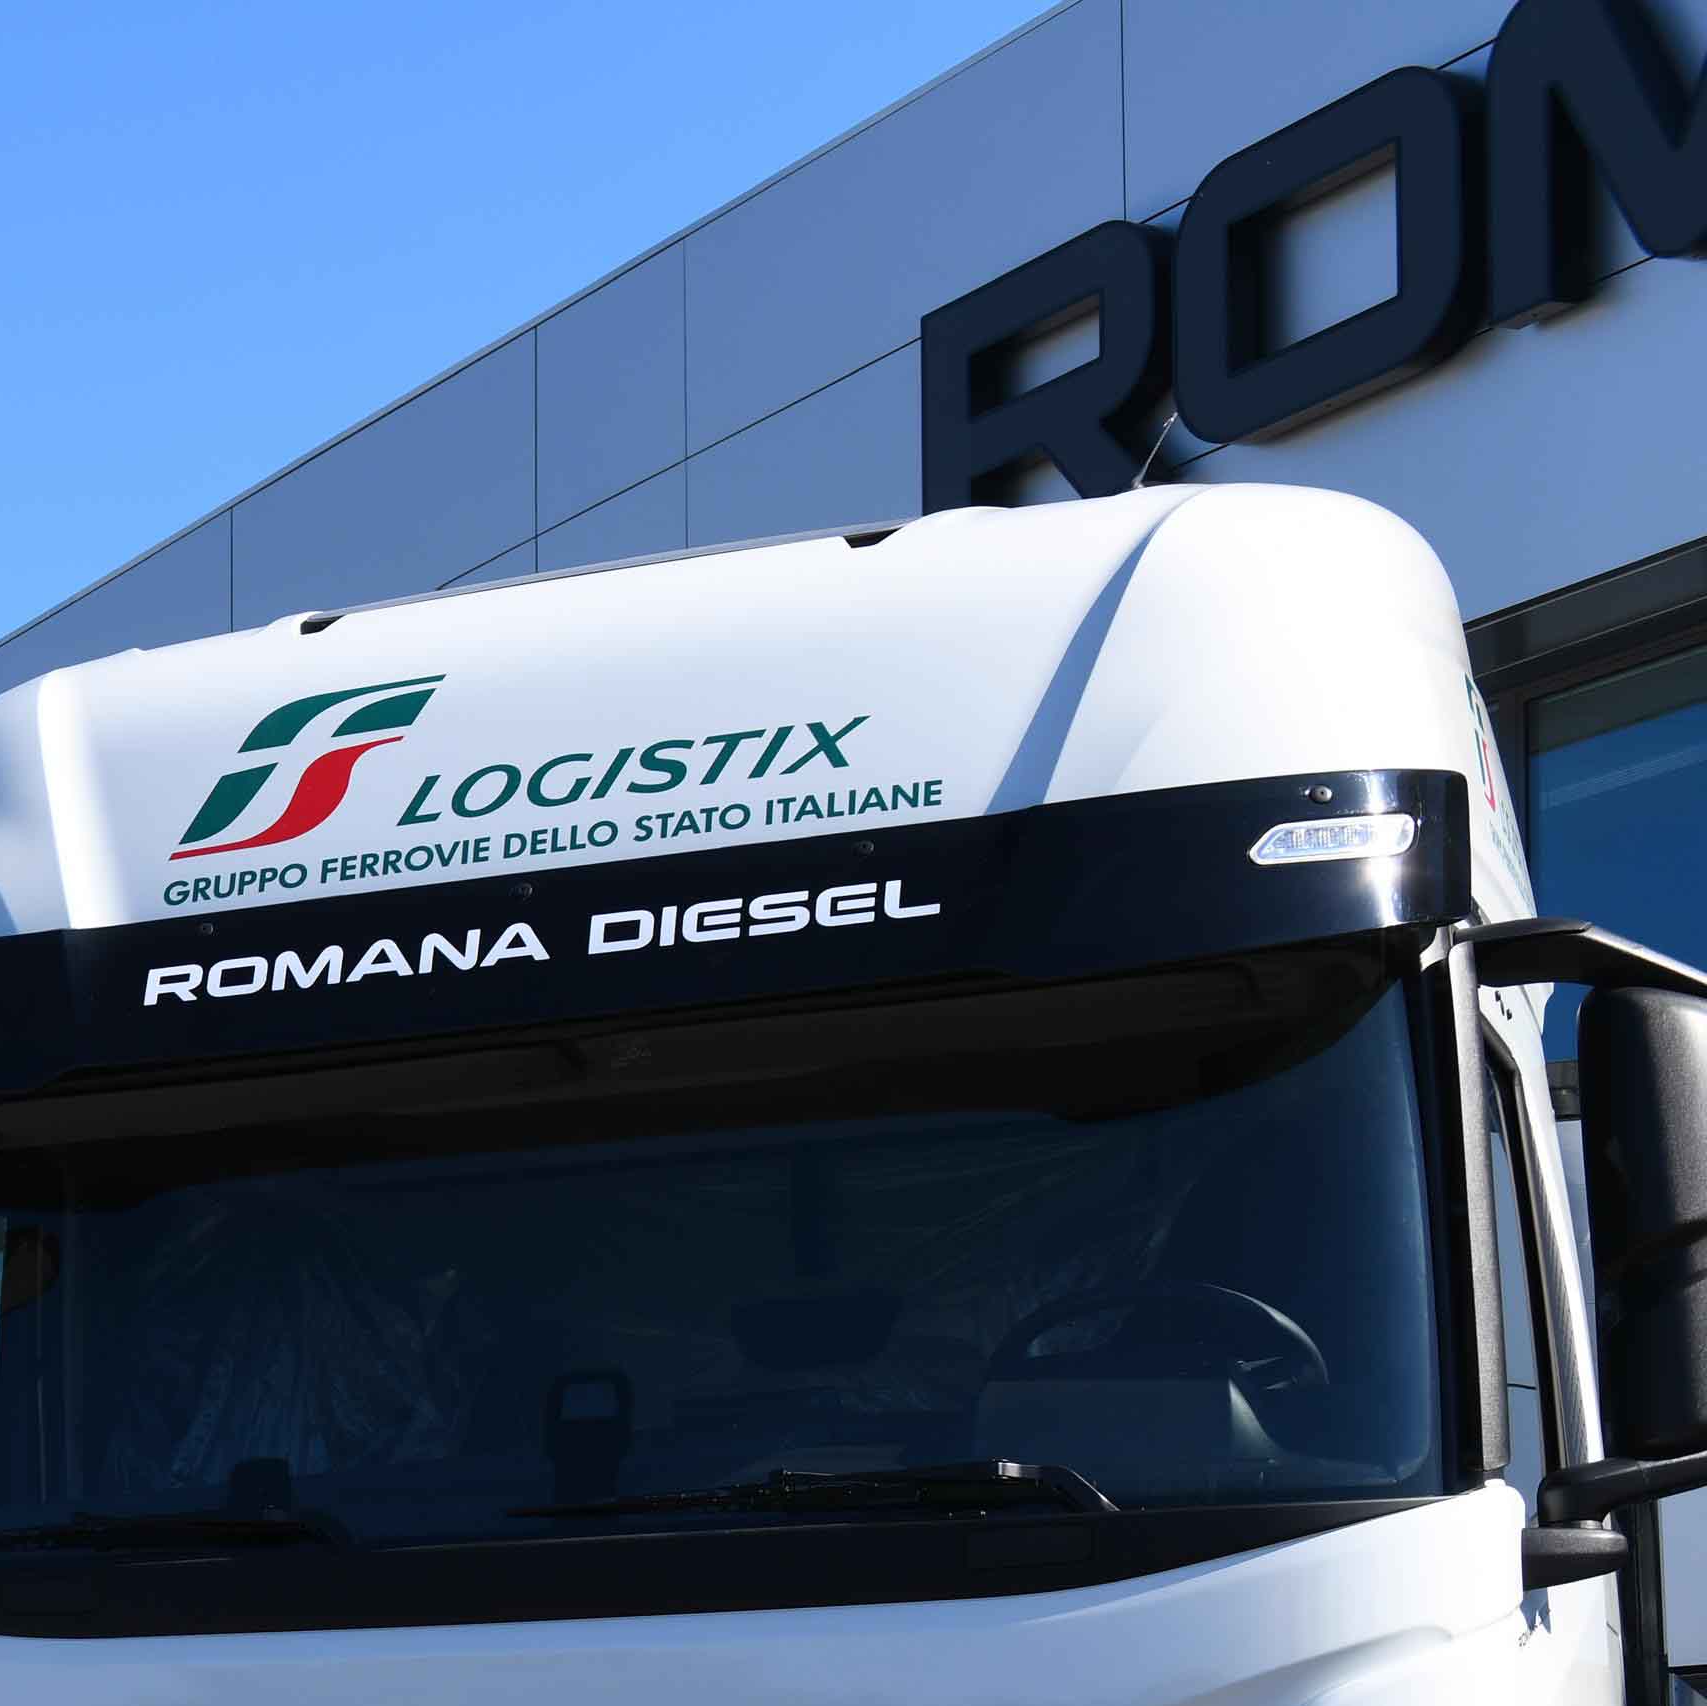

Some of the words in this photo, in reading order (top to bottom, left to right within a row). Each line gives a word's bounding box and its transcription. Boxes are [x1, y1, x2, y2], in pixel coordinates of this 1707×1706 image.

[397, 716, 869, 827] LOGISTIX
[164, 864, 307, 905] GRUPPO
[321, 837, 490, 883] FERROVIE
[503, 821, 618, 858] DELLO
[633, 801, 750, 841] STATO
[766, 780, 942, 825] ITALIANE
[144, 923, 549, 1005] ROMANA
[589, 880, 940, 954] DIESEL
